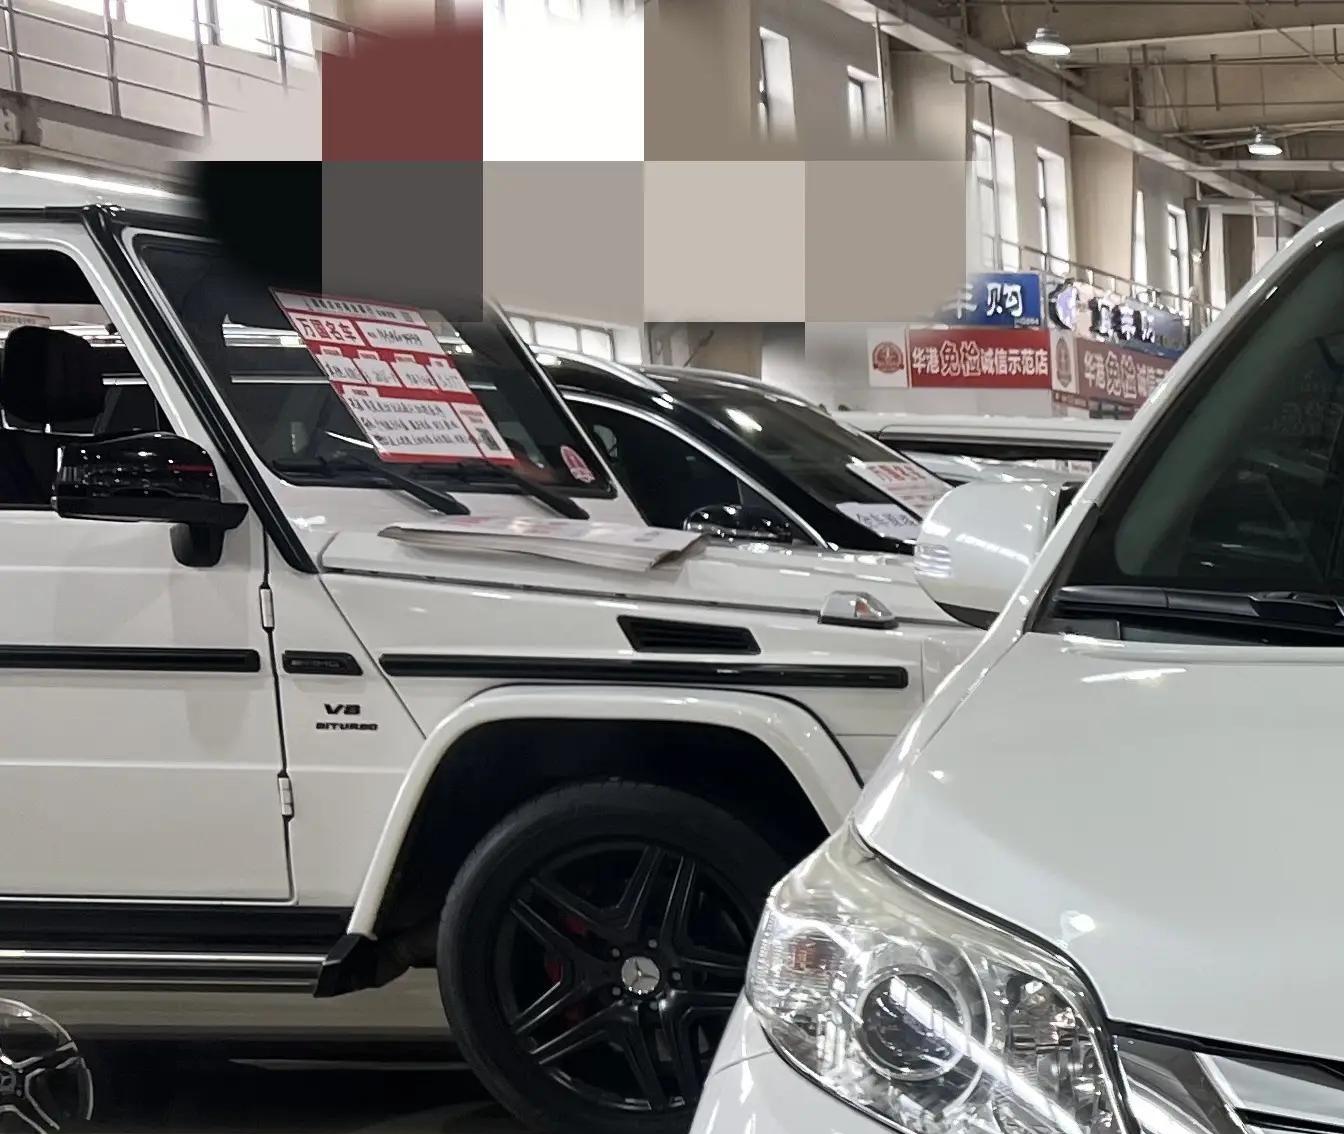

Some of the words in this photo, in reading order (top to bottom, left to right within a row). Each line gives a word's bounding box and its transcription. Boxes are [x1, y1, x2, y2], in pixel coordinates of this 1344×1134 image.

[296, 316, 358, 342] 万国名车
[911, 339, 1049, 378] 华港免检诚信示范店
[323, 703, 361, 715] V8
[315, 722, 379, 731] BITURBO
